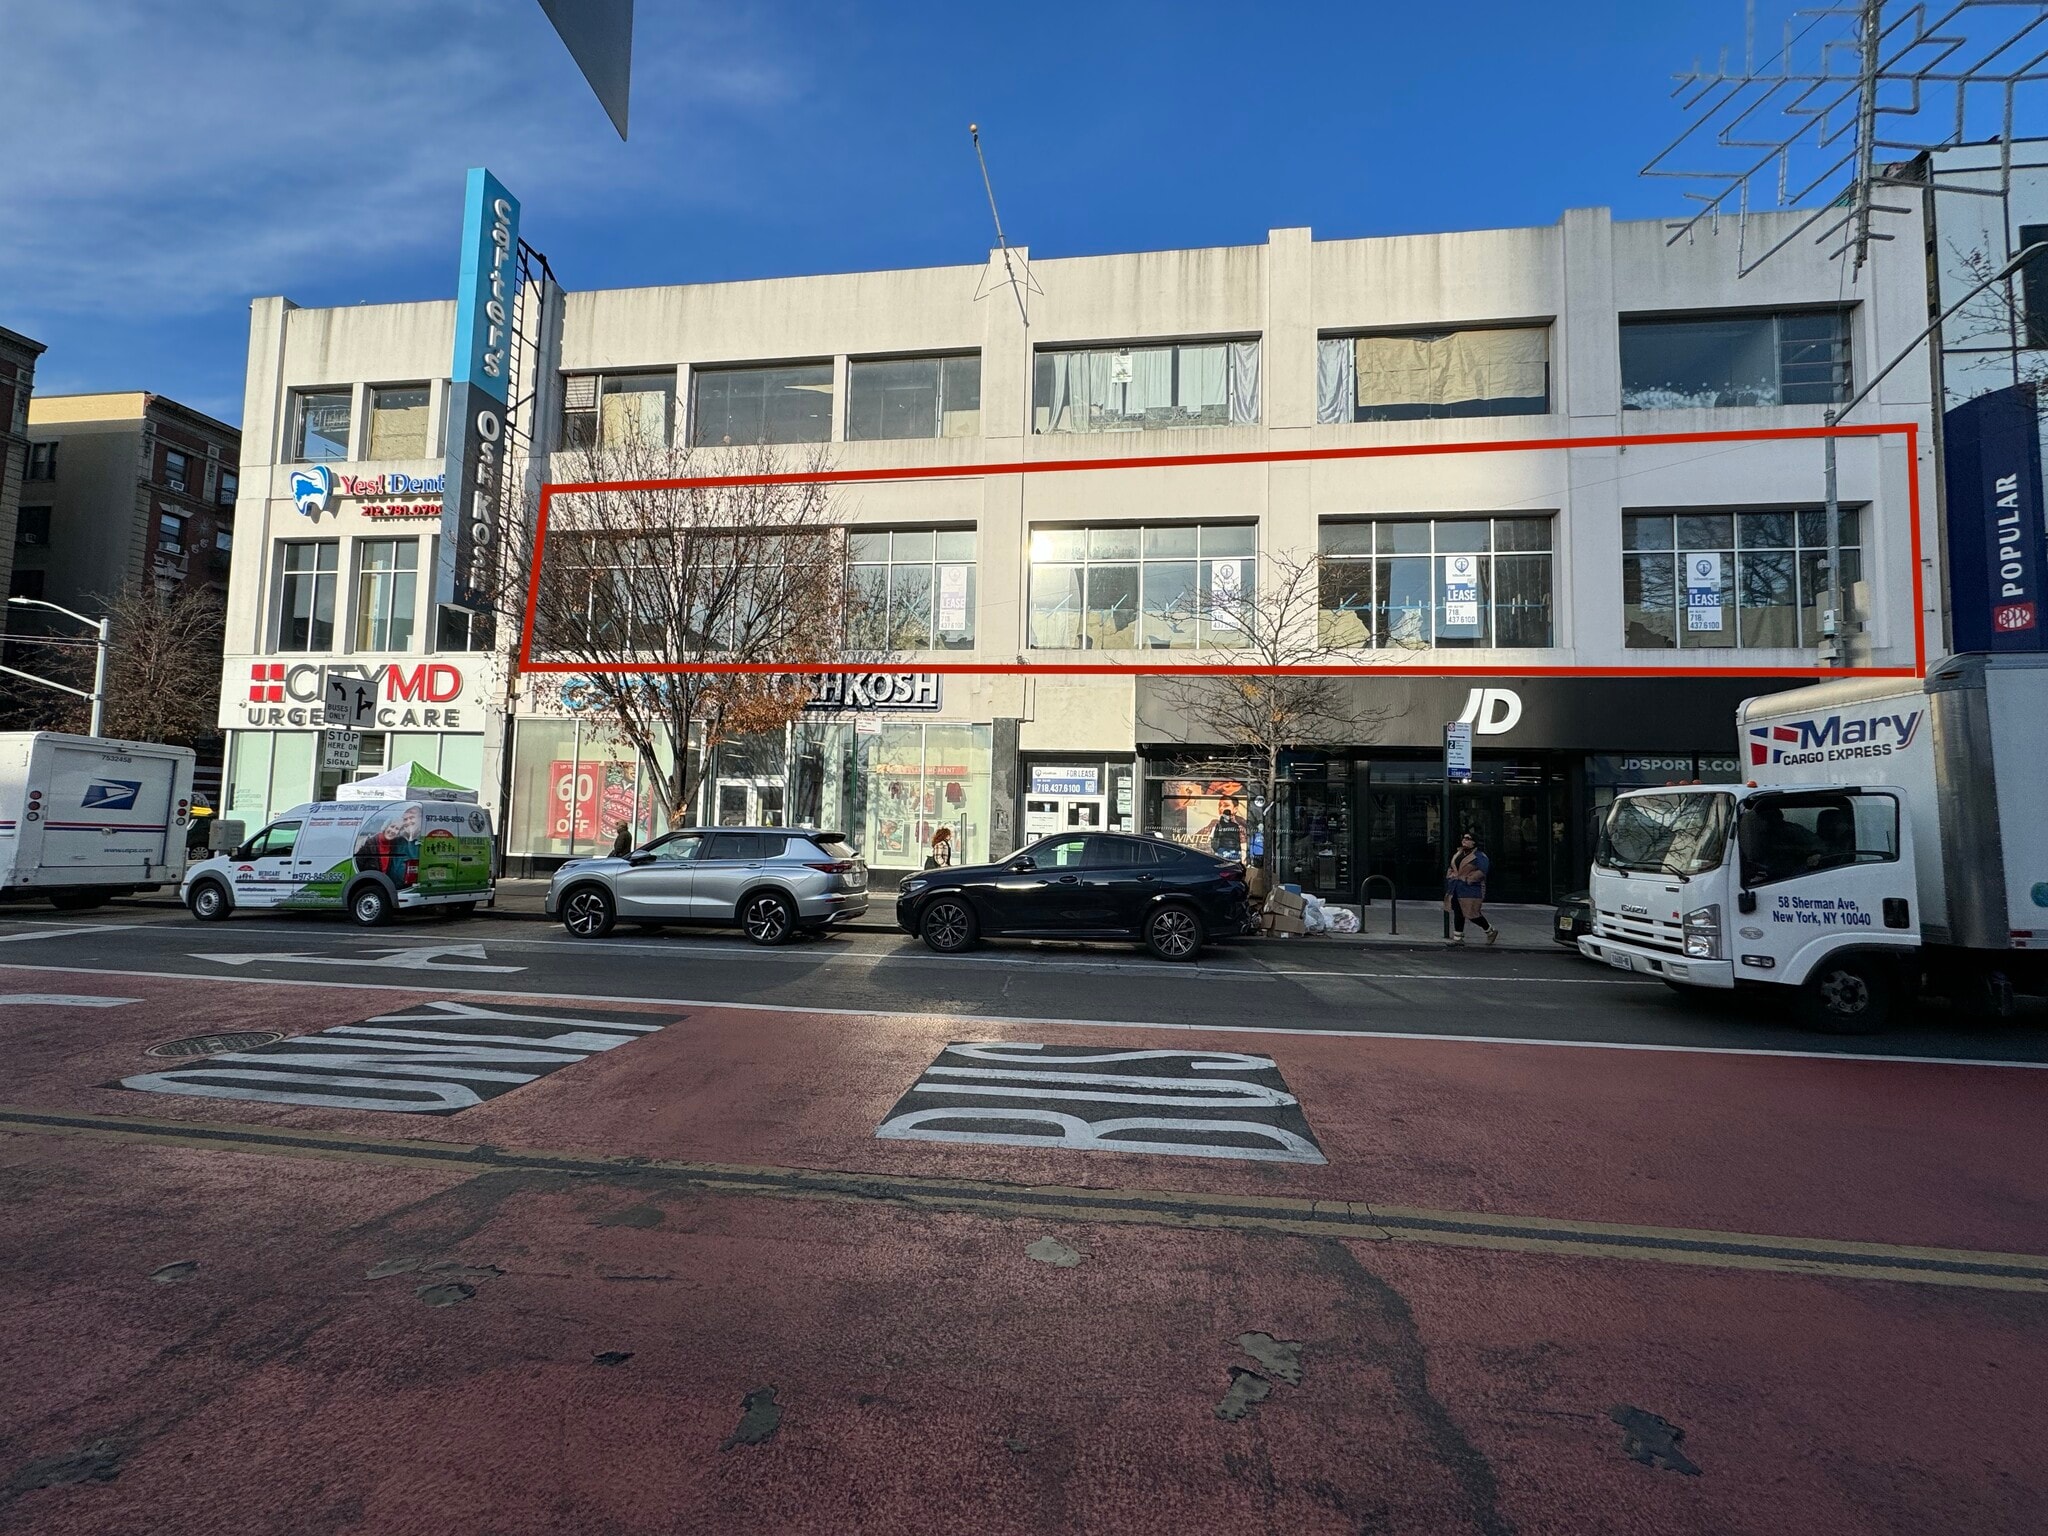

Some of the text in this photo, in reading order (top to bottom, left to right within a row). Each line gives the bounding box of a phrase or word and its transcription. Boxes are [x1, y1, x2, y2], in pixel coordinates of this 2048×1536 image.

[340, 473, 445, 495] Yes! Dent
[1996, 473, 2024, 597] POPULAR
[1447, 590, 1476, 600] LEASE
[1689, 594, 1720, 605] LEASE
[942, 598, 965, 608] LEASE
[327, 704, 349, 713] BUSES
[1456, 688, 1522, 735] JD
[247, 708, 461, 727] URGE CARE
[329, 712, 346, 720] ONLY
[1784, 711, 1919, 750] Mary
[328, 731, 359, 742] STOP
[327, 742, 347, 750] HERE
[101, 754, 132, 763] 7532458
[1783, 743, 1892, 766] CARGO EXPRESS
[326, 758, 356, 767] SIGNAL
[556, 773, 593, 801] 60
[1036, 783, 1081, 793] 718.437.6100
[1621, 904, 1648, 915] ISUZU
[1778, 896, 1859, 912] 58 Sherman Ave,
[1772, 910, 1871, 926] New York, NY 10040
[874, 1042, 1329, 1165] BUS
